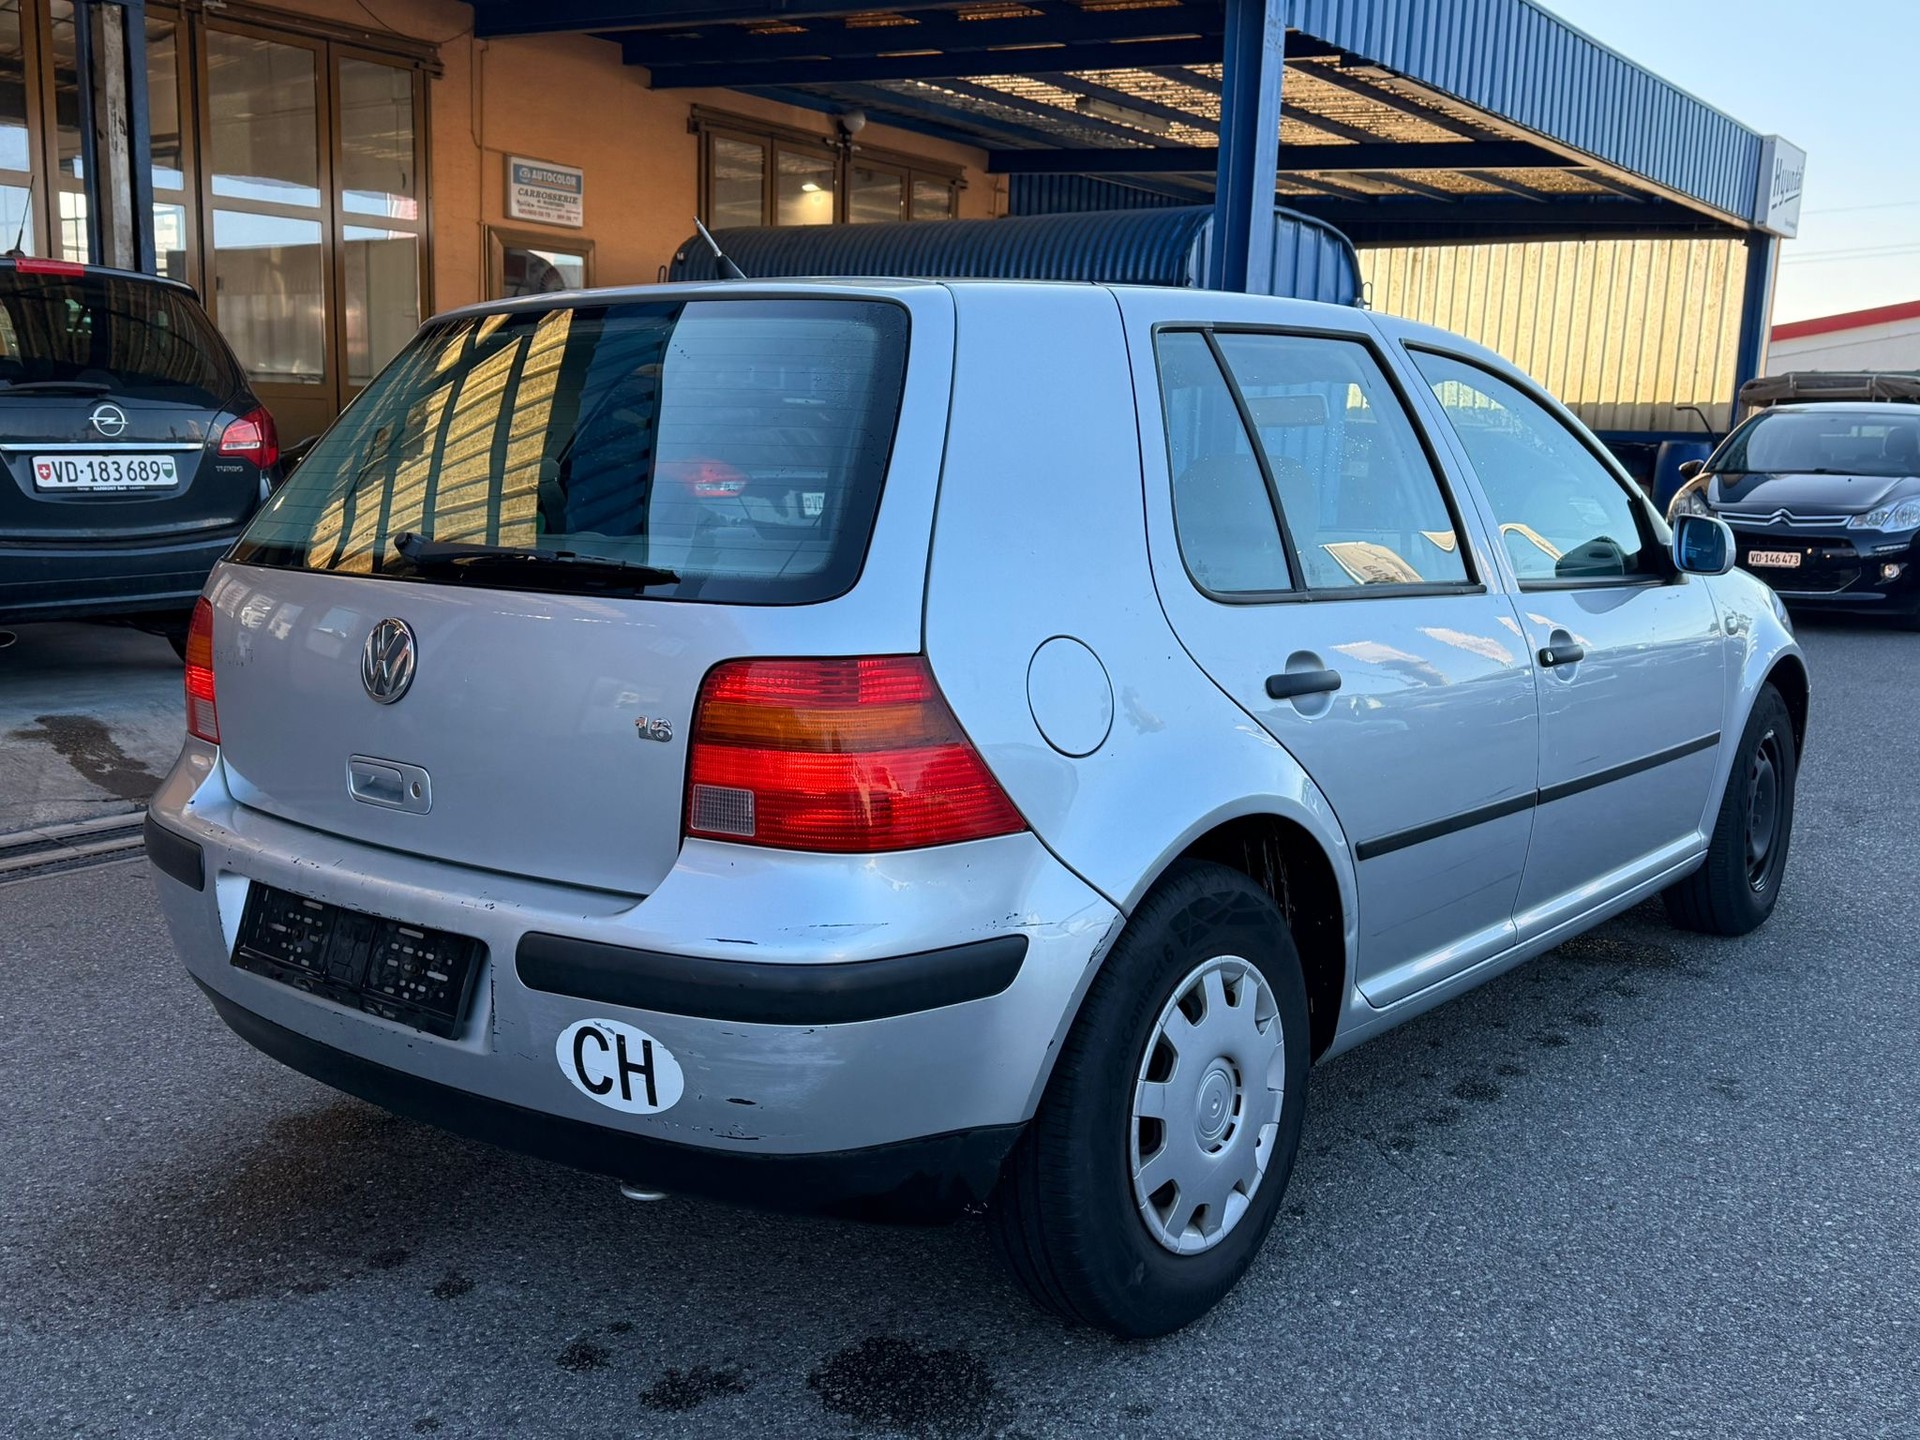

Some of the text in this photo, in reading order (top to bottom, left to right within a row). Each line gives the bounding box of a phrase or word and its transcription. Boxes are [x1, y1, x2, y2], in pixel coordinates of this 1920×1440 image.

[531, 169, 577, 185] AUTOCOLOR
[517, 187, 579, 205] CARROSSERIE
[573, 1025, 659, 1108] CH
